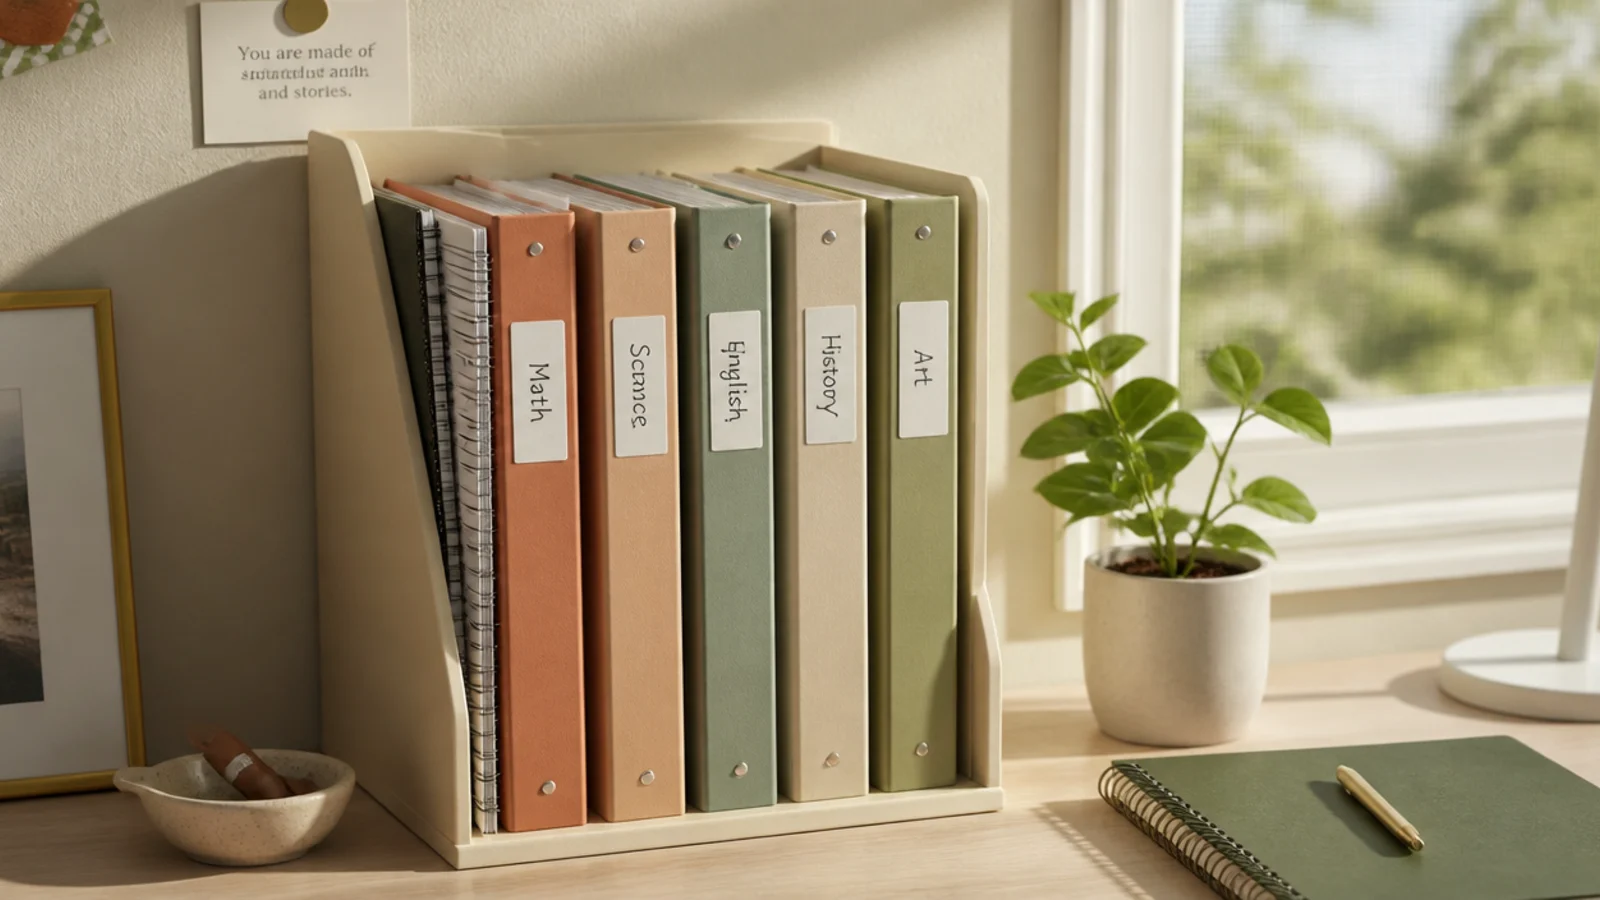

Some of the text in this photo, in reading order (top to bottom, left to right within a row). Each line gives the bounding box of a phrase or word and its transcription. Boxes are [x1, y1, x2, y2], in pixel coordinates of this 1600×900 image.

[237, 42, 377, 61] You are made of
[258, 84, 352, 100] and stories.
[913, 349, 934, 387] Art
[528, 363, 553, 423] Math
